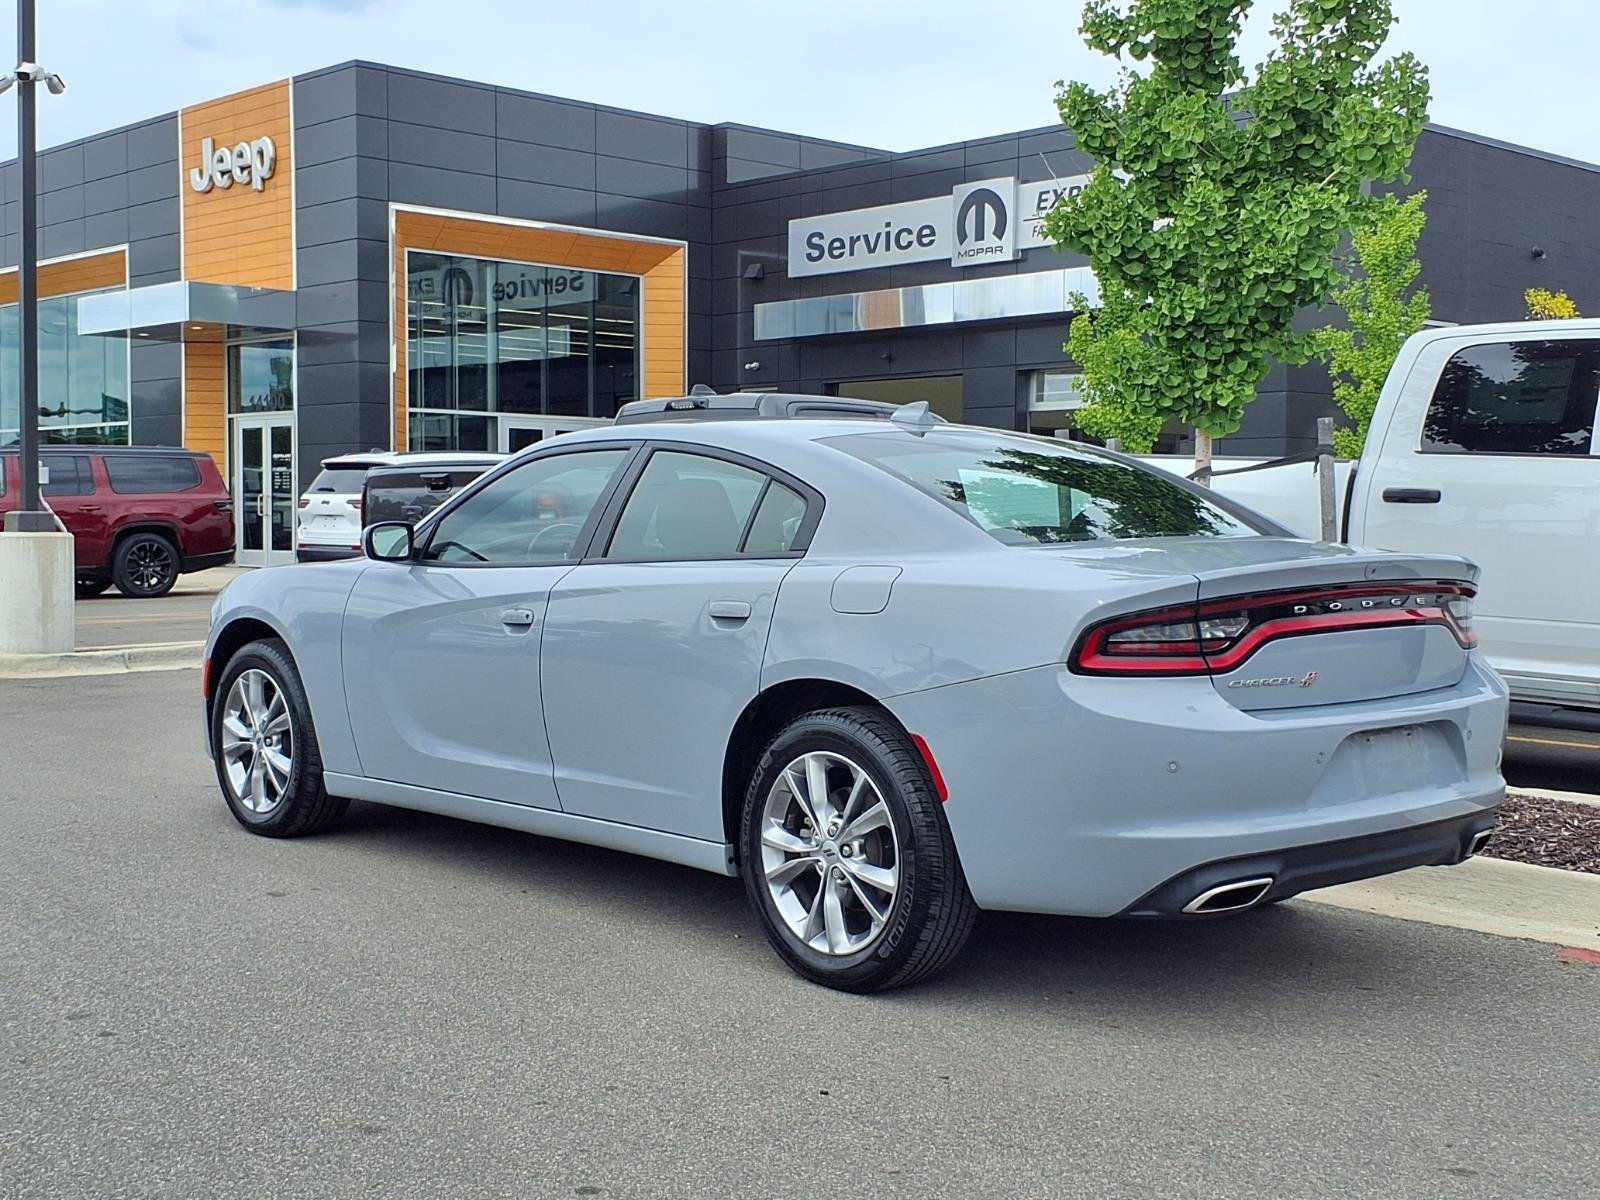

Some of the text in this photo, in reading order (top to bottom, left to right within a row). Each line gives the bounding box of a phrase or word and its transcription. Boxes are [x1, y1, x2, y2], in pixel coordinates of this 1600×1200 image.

[190, 136, 276, 193] Jeep
[1036, 183, 1089, 211] EXP
[805, 222, 937, 263] Service
[957, 246, 1004, 259] MOPAR
[1294, 597, 1426, 614] DODGE
[1228, 676, 1296, 689] CHARGER
